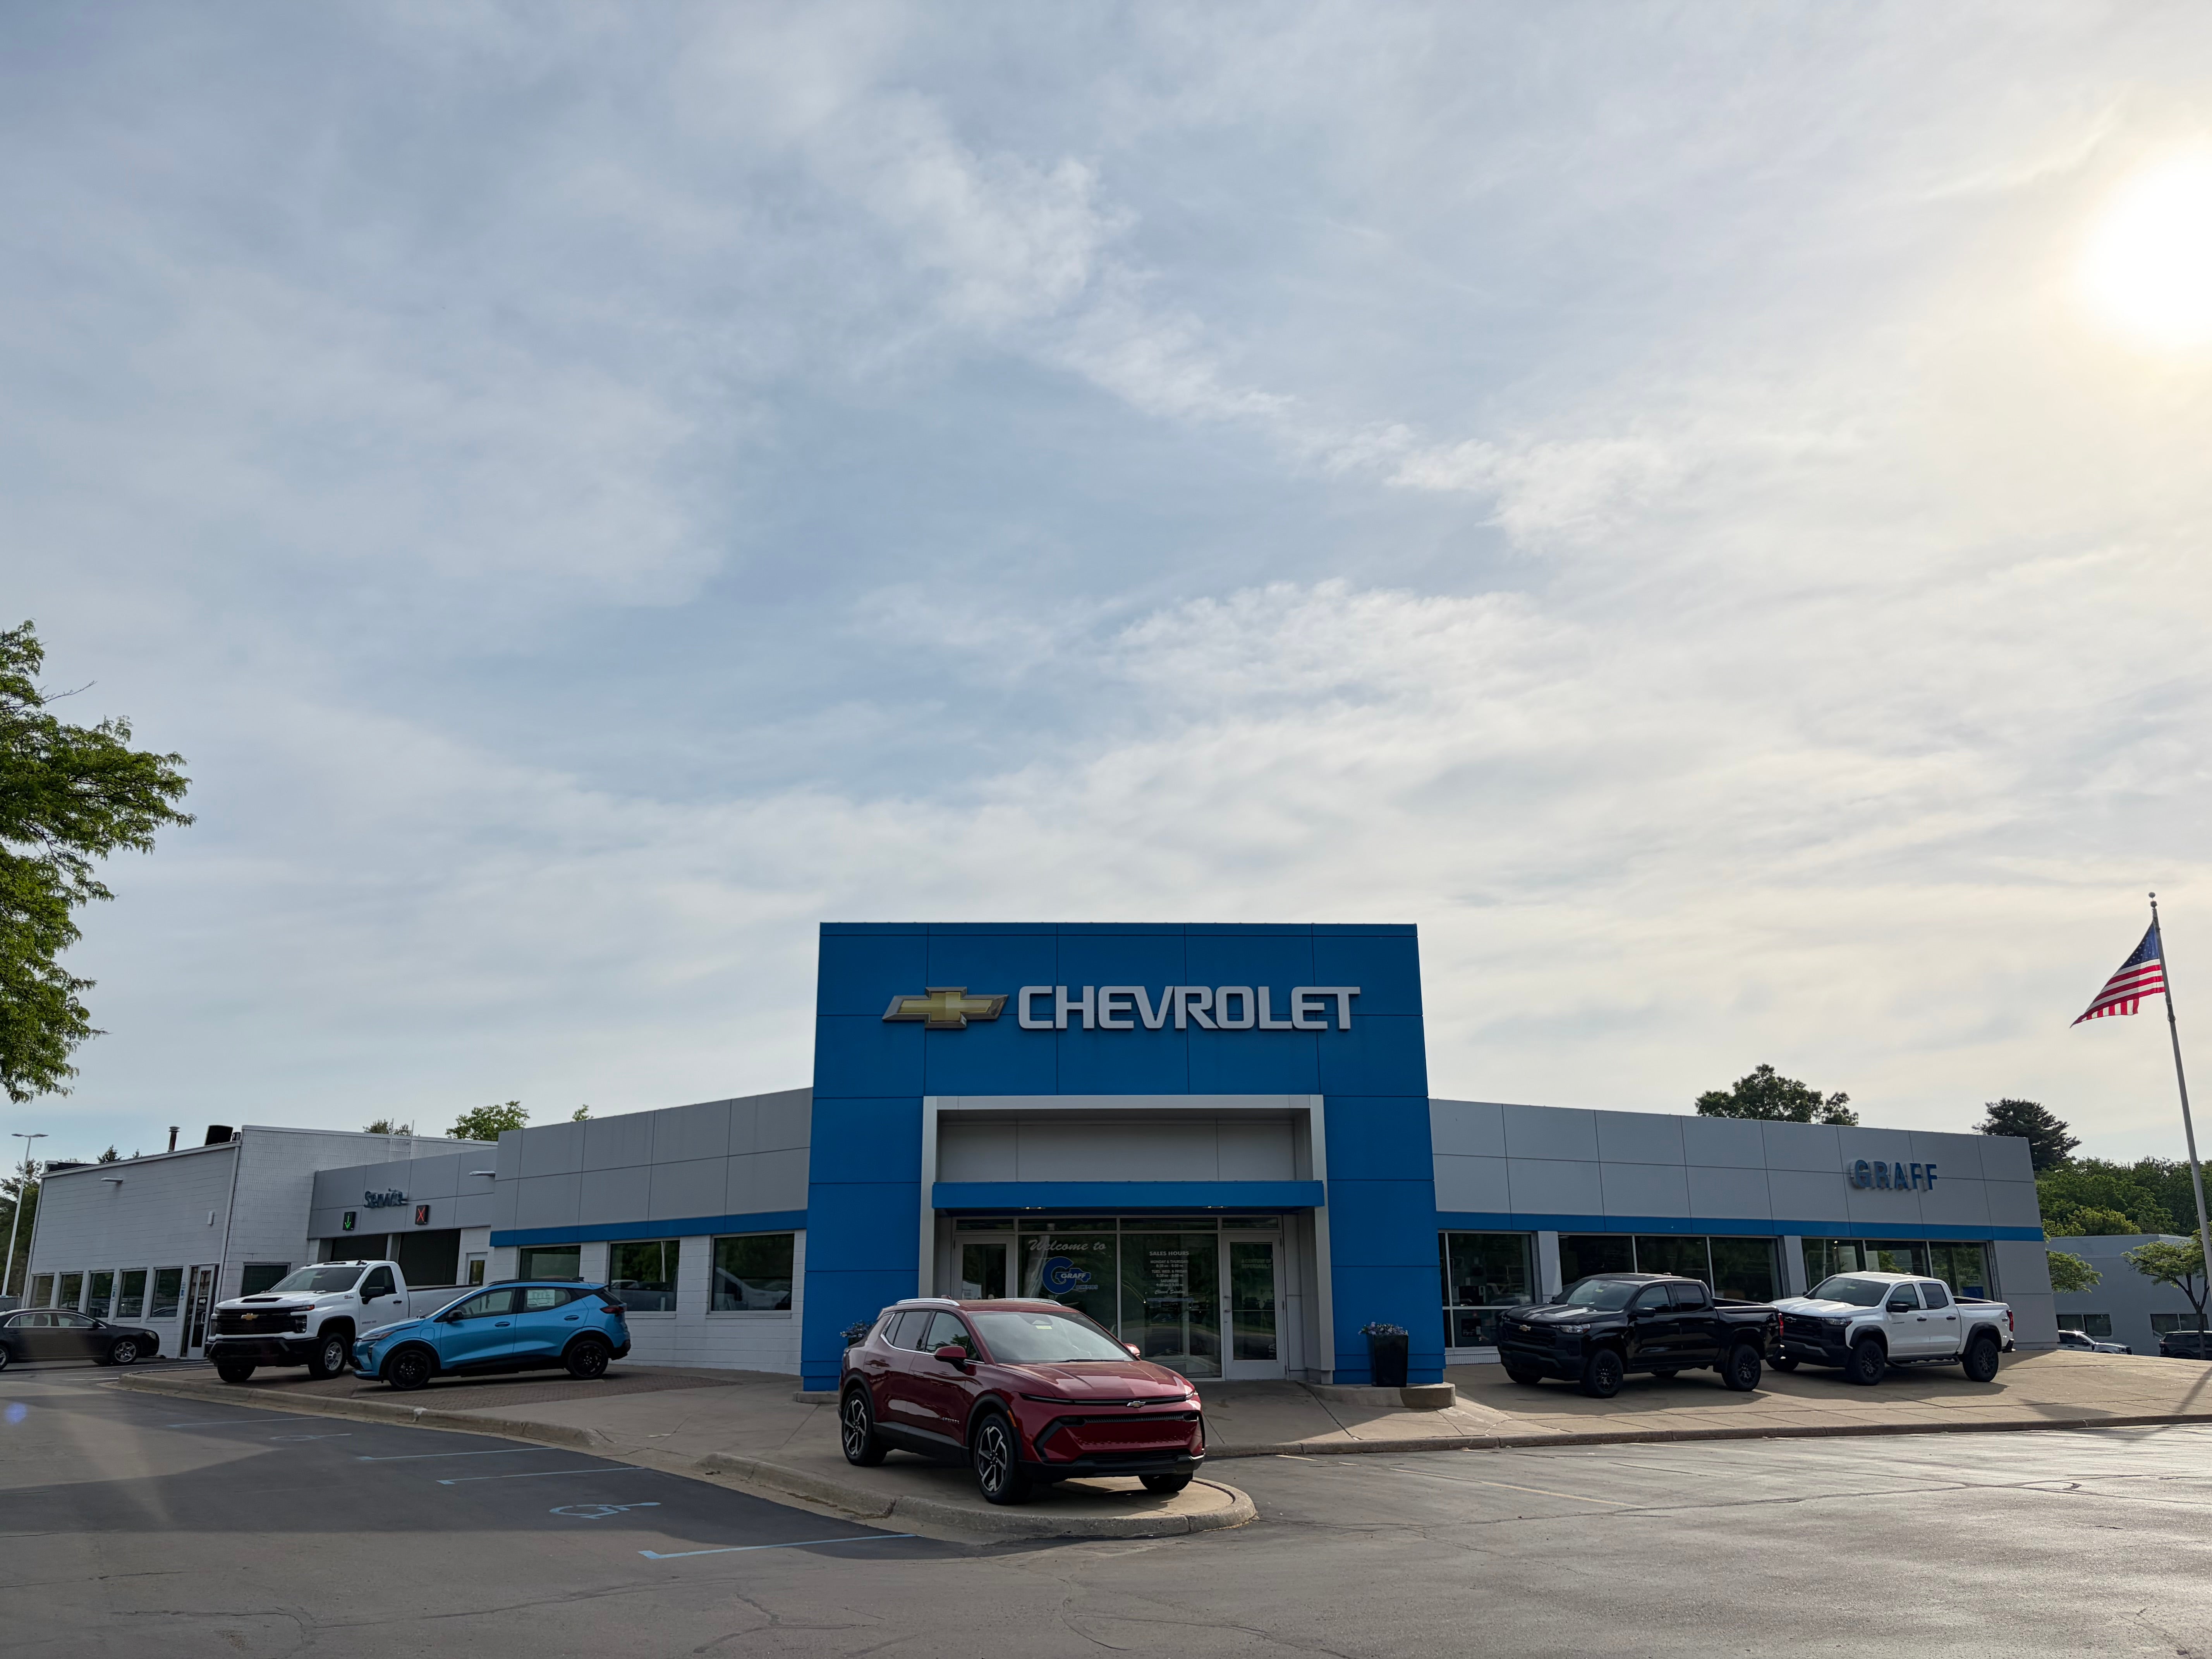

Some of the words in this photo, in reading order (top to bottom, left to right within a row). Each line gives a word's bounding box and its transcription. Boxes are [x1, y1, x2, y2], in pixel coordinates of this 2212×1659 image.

[1018, 985, 1360, 1030] CHEVROLET
[1853, 1159, 1937, 1190] GRAFF
[364, 1188, 409, 1208] Service
[1028, 1239, 1089, 1250] Welcome
[1092, 1242, 1106, 1250] to
